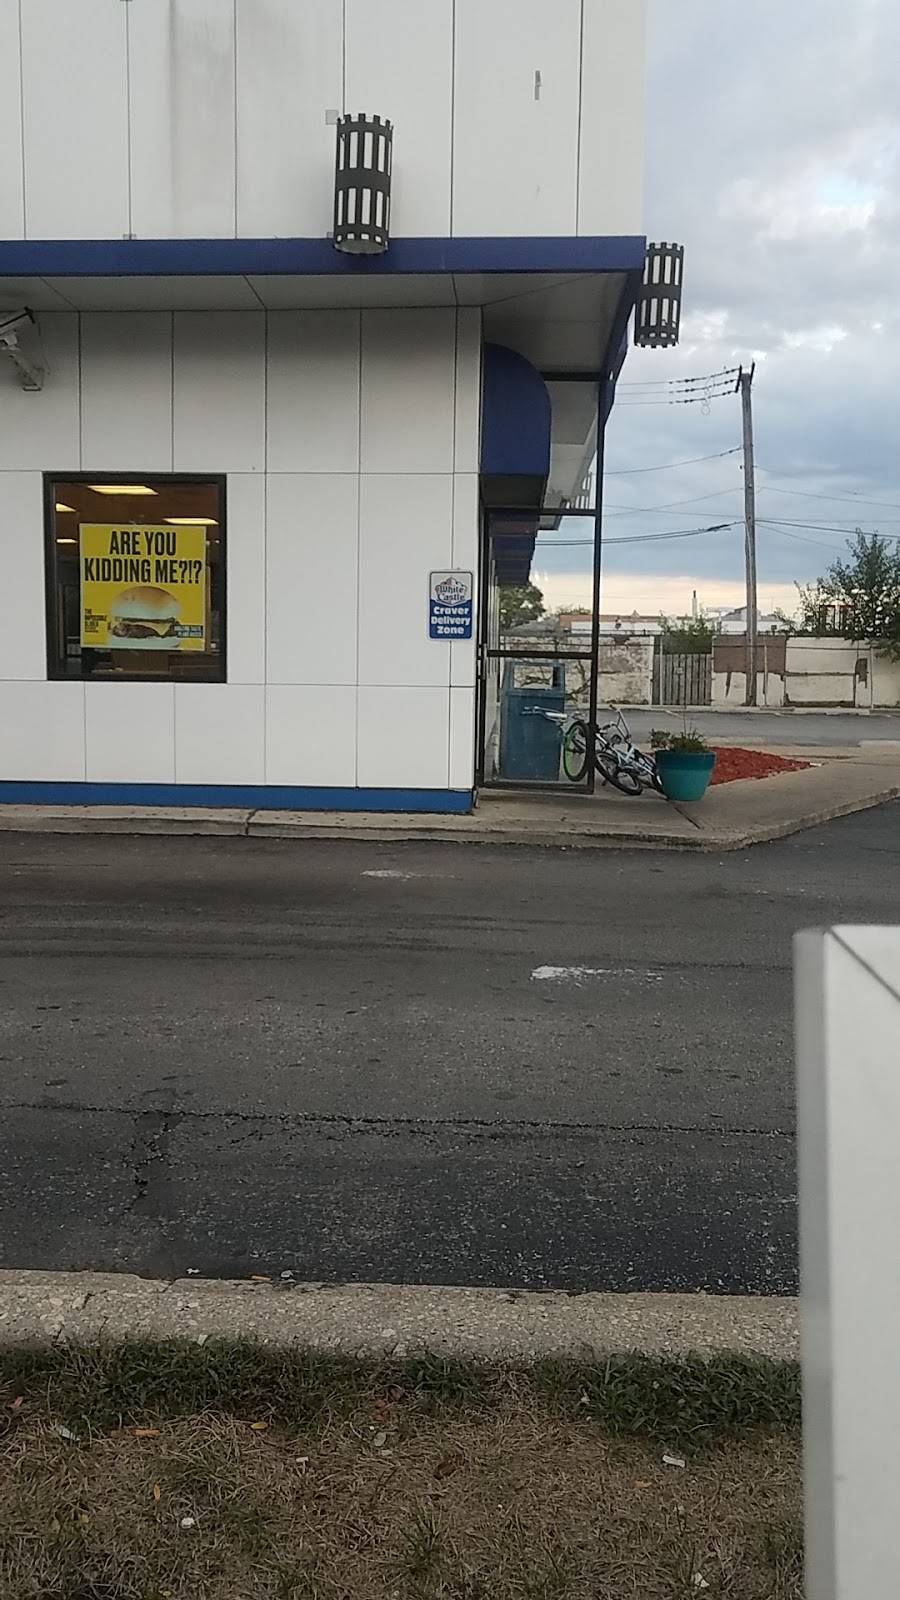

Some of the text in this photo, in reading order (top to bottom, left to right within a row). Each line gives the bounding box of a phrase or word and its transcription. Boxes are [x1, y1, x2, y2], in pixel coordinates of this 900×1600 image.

[109, 530, 177, 556] ARE YOU
[84, 558, 202, 584] KIDDING ME?!?
[433, 606, 470, 615] Craver
[430, 616, 471, 626] Delivery
[436, 626, 465, 635] Zone
